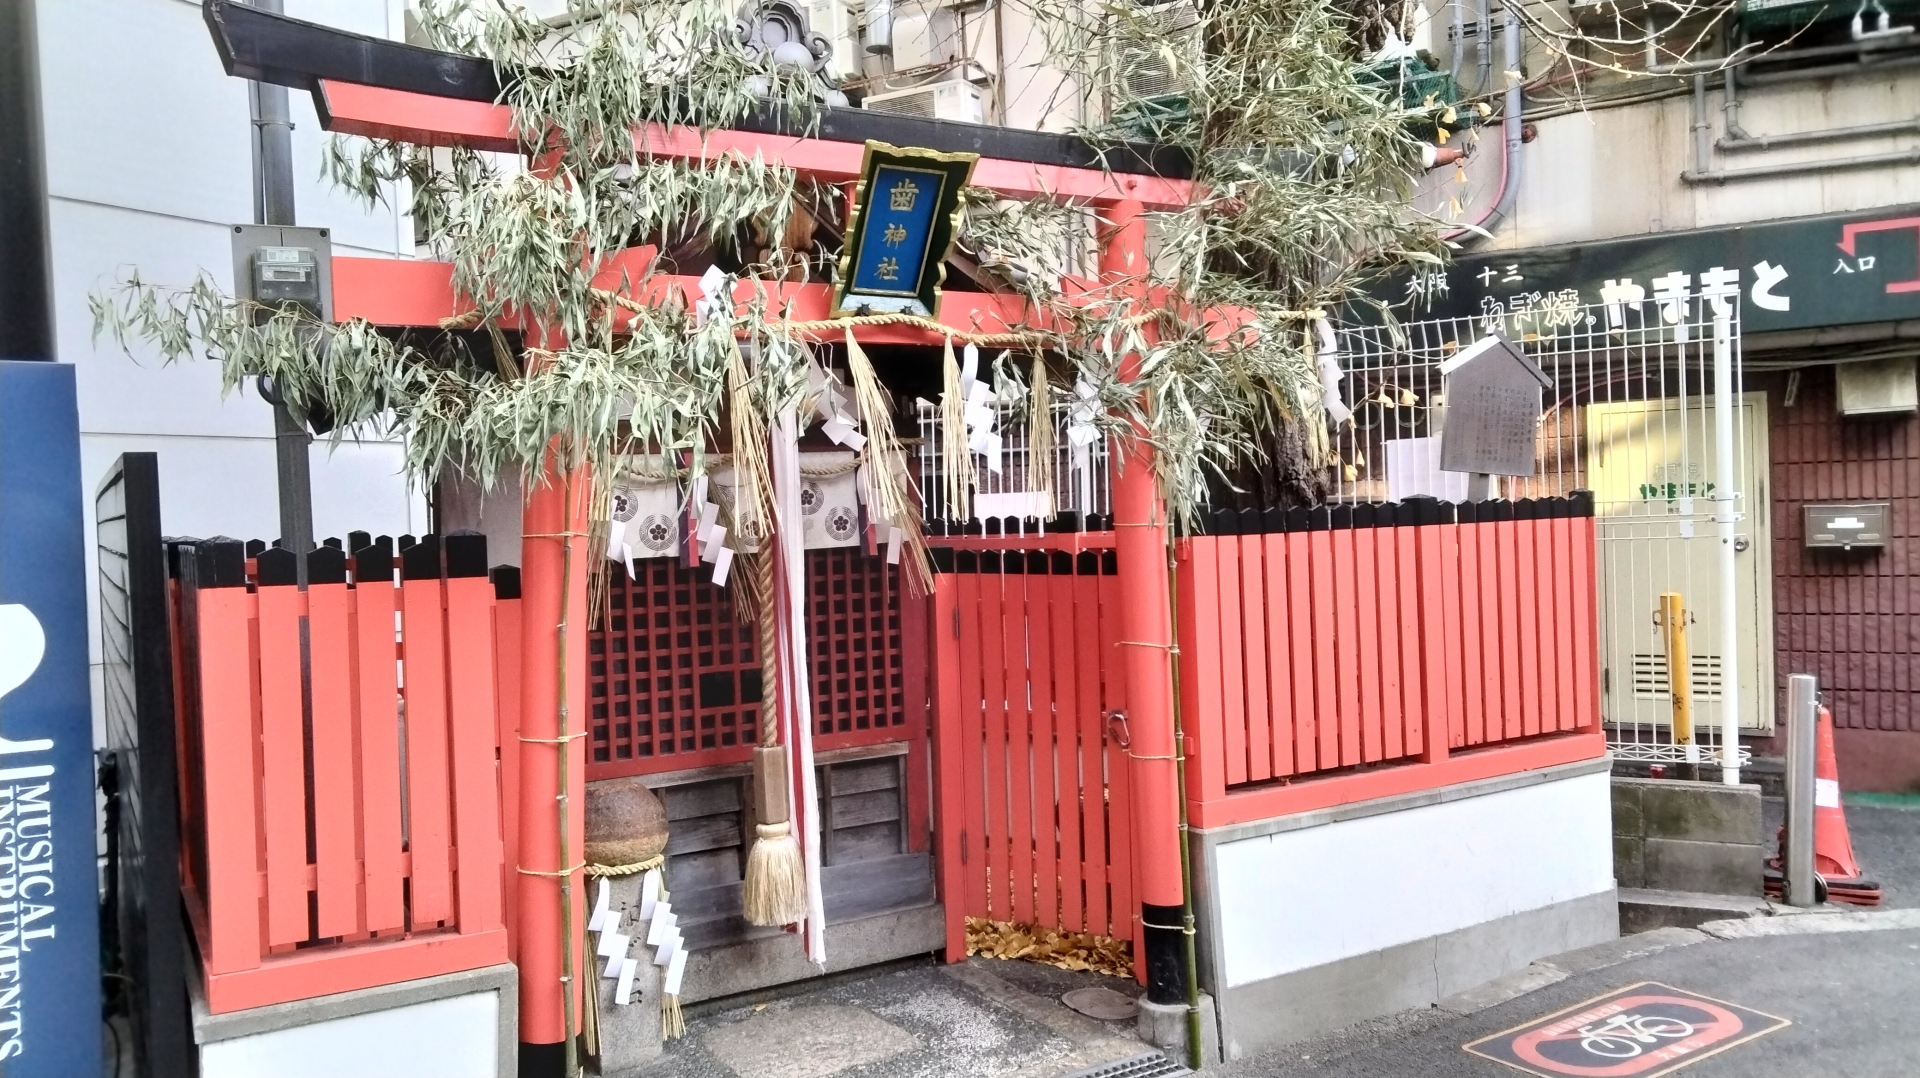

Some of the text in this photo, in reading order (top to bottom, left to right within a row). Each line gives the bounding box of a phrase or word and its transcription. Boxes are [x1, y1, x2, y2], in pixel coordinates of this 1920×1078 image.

[874, 178, 920, 281] 歯神社
[1475, 264, 1525, 288] 十三
[1600, 259, 1791, 328] やまもと
[1832, 256, 1877, 275] 入口
[15, 780, 56, 952] MUSICAL
